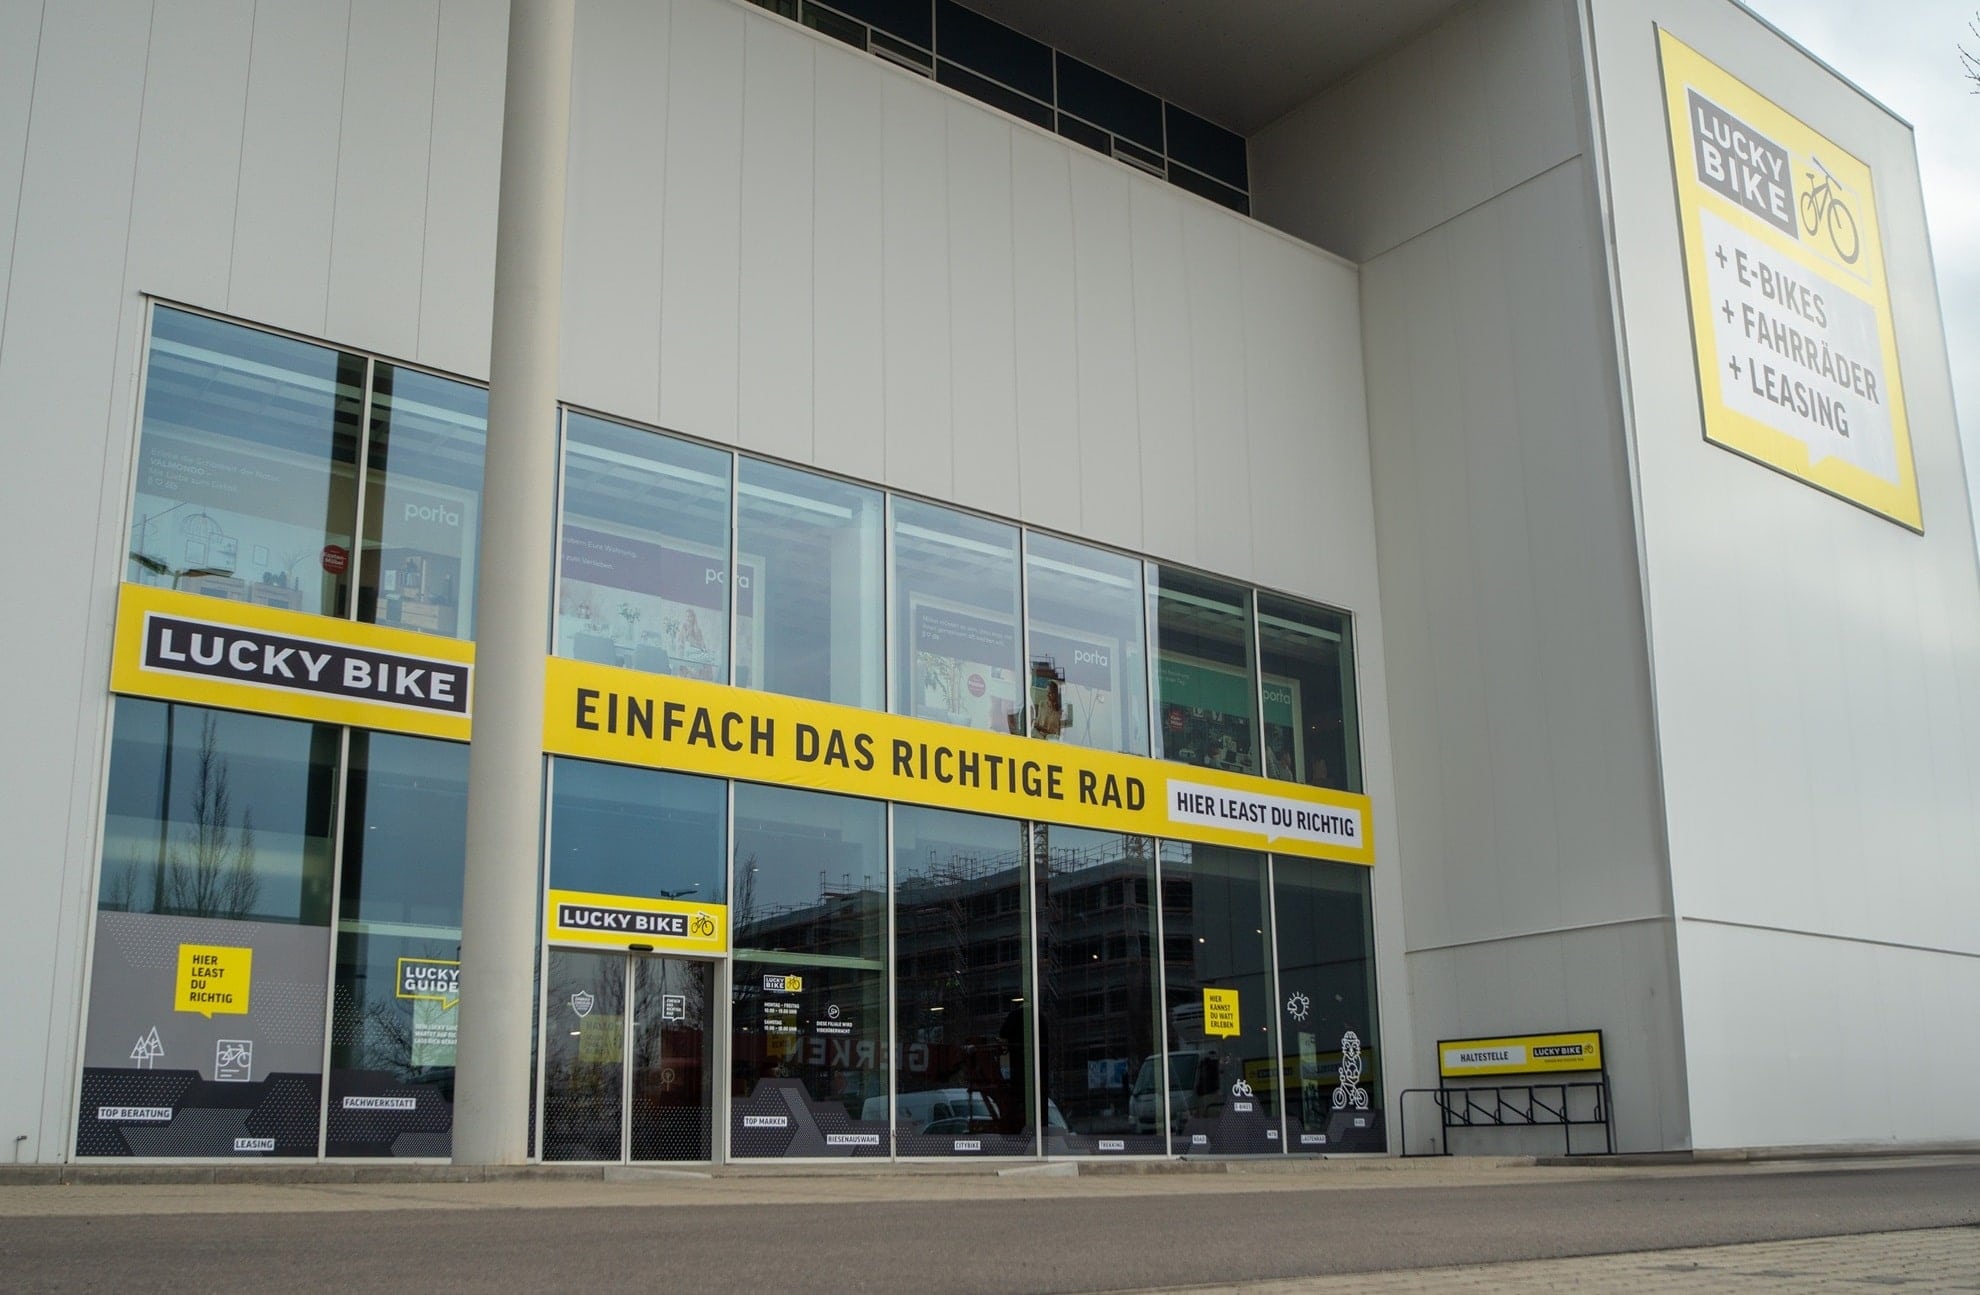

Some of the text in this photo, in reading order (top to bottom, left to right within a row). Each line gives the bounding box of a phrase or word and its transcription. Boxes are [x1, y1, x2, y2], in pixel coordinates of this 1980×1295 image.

[1697, 106, 1782, 181] LUCKY
[1702, 139, 1788, 223] BIKE
[1735, 247, 1827, 329] E-BIKES
[1742, 302, 1880, 405] FAHRRÄDER
[1749, 357, 1850, 438] LEASING
[404, 503, 459, 527] porta
[159, 627, 456, 703] LUCKY BIKE
[1074, 649, 1108, 667] porta
[1262, 687, 1291, 705] porta
[576, 688, 1146, 811] EINFACH DAS RICHTIGE RAD
[1177, 791, 1355, 838] HIER LEAST DU RICHTIG
[563, 909, 683, 932] LUCKY BIKE
[192, 954, 218, 966] HIER
[191, 967, 225, 978] LEAST
[405, 966, 460, 981] LUCKY
[190, 979, 207, 990] DU
[404, 979, 459, 993] GUIDE
[189, 991, 233, 1004] RICHTIG
[1210, 1020, 1234, 1028] ERLEBEN
[1460, 1051, 1509, 1062] HALTESTELLE
[1534, 1046, 1581, 1056] LUCKY BIKE
[344, 1097, 415, 1108] FACHWERKSTATT
[100, 1108, 171, 1119] TOP BERATUNG
[745, 1117, 786, 1126] TOP MARKEN
[235, 1139, 274, 1150] LEASING
[827, 1135, 879, 1144] RIESENAUSWAHL
